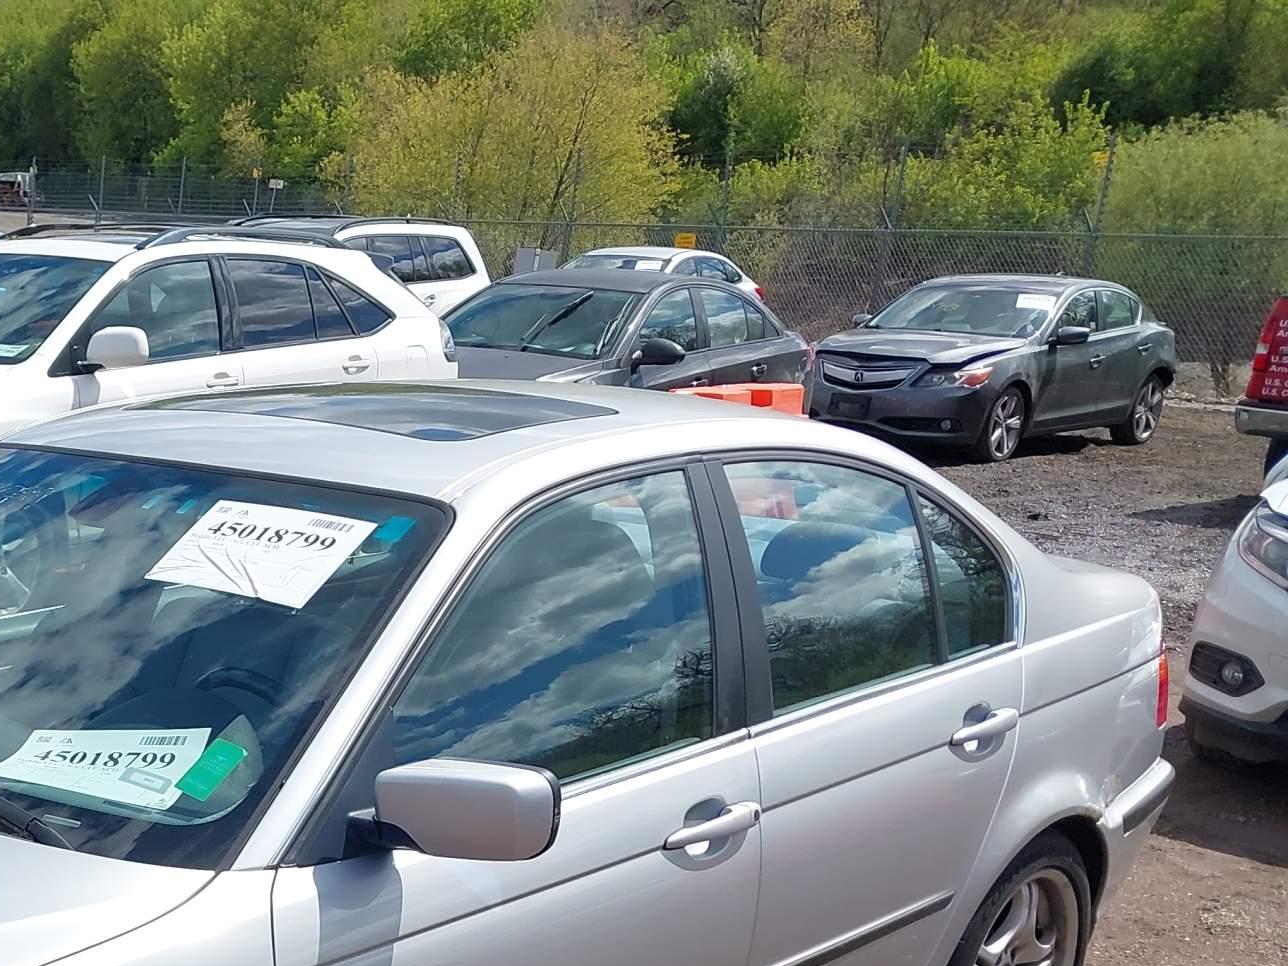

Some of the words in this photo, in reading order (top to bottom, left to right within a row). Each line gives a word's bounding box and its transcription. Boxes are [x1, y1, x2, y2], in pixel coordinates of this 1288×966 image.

[1268, 365, 1288, 373] Am
[207, 520, 337, 551] 45018799
[33, 749, 176, 769] 45018799
